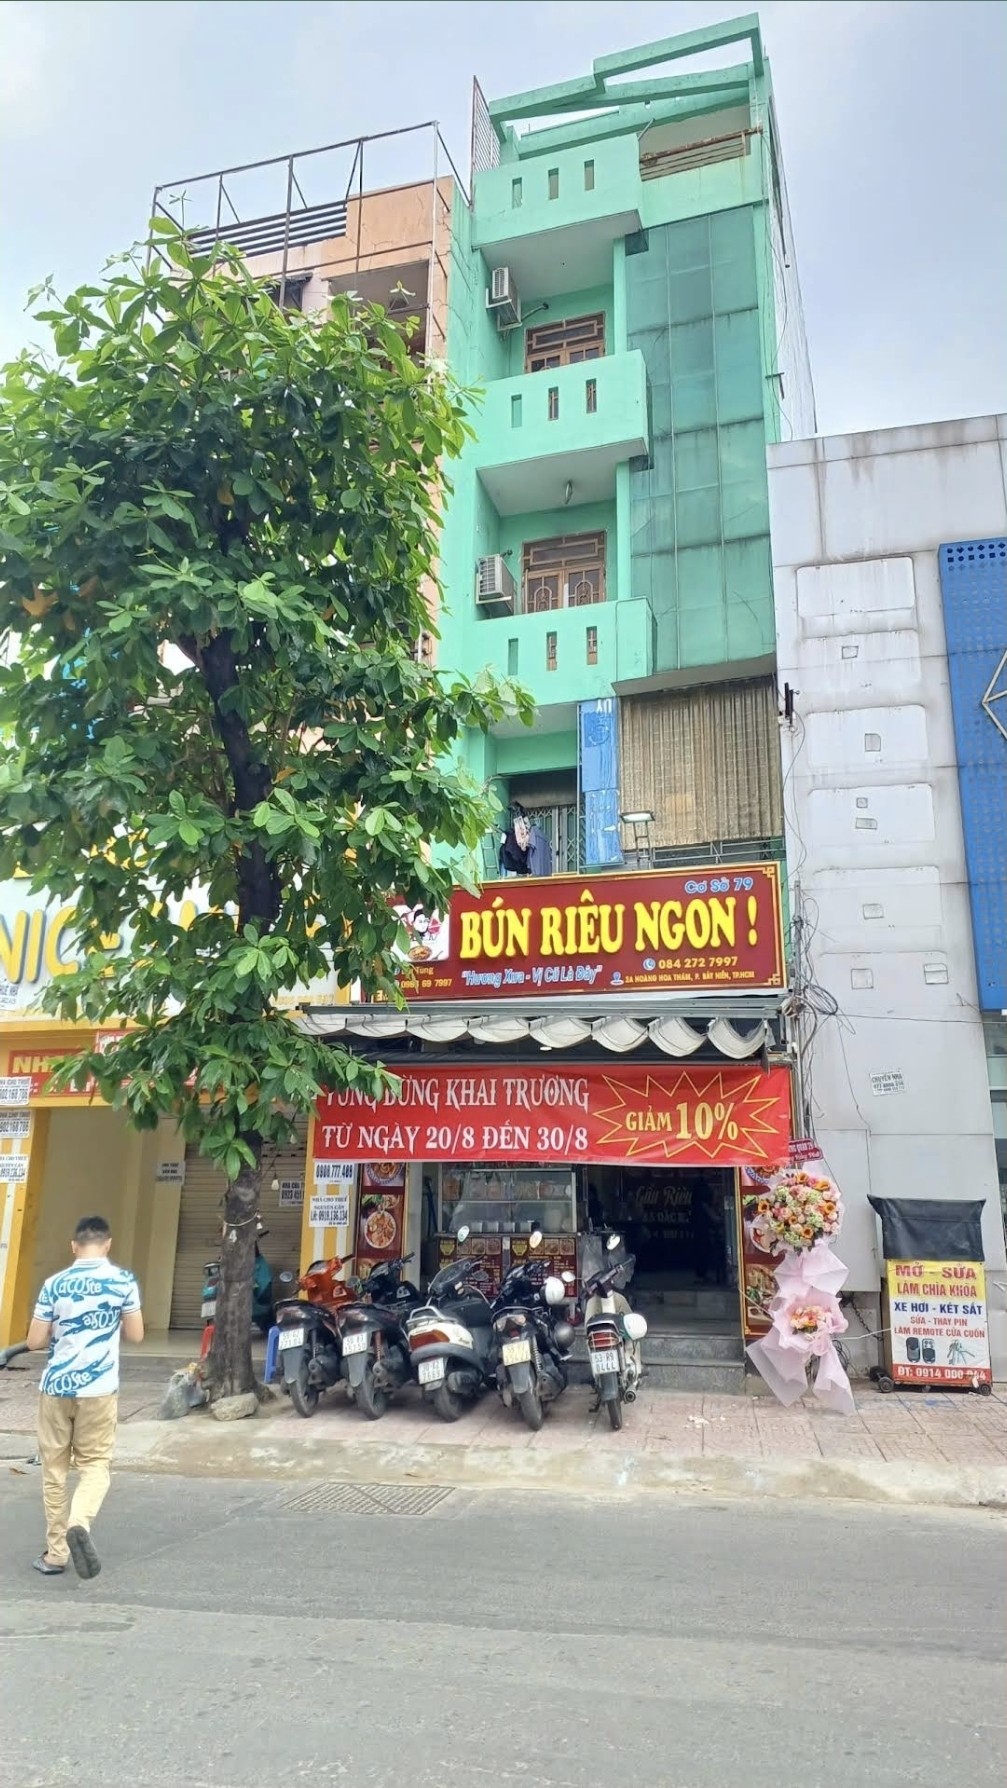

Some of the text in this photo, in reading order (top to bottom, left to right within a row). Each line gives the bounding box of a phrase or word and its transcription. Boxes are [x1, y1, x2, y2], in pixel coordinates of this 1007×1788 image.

[685, 876, 753, 894] Cơ Sở 79
[460, 896, 532, 958] BÚN
[540, 889, 625, 955] RIÊU
[634, 896, 736, 952] NGON
[658, 956, 738, 970] 084 272 7997
[445, 1078, 497, 1112] KHAI
[625, 1102, 738, 1140] GIẢM 10%
[322, 1119, 588, 1156] TỪ NGÀY 20/8 ĐẾN 30/8
[894, 1302, 908, 1312] XE
[911, 1302, 929, 1312] HƠI
[954, 1318, 968, 1327] PIN
[913, 1328, 944, 1336] REMOTE
